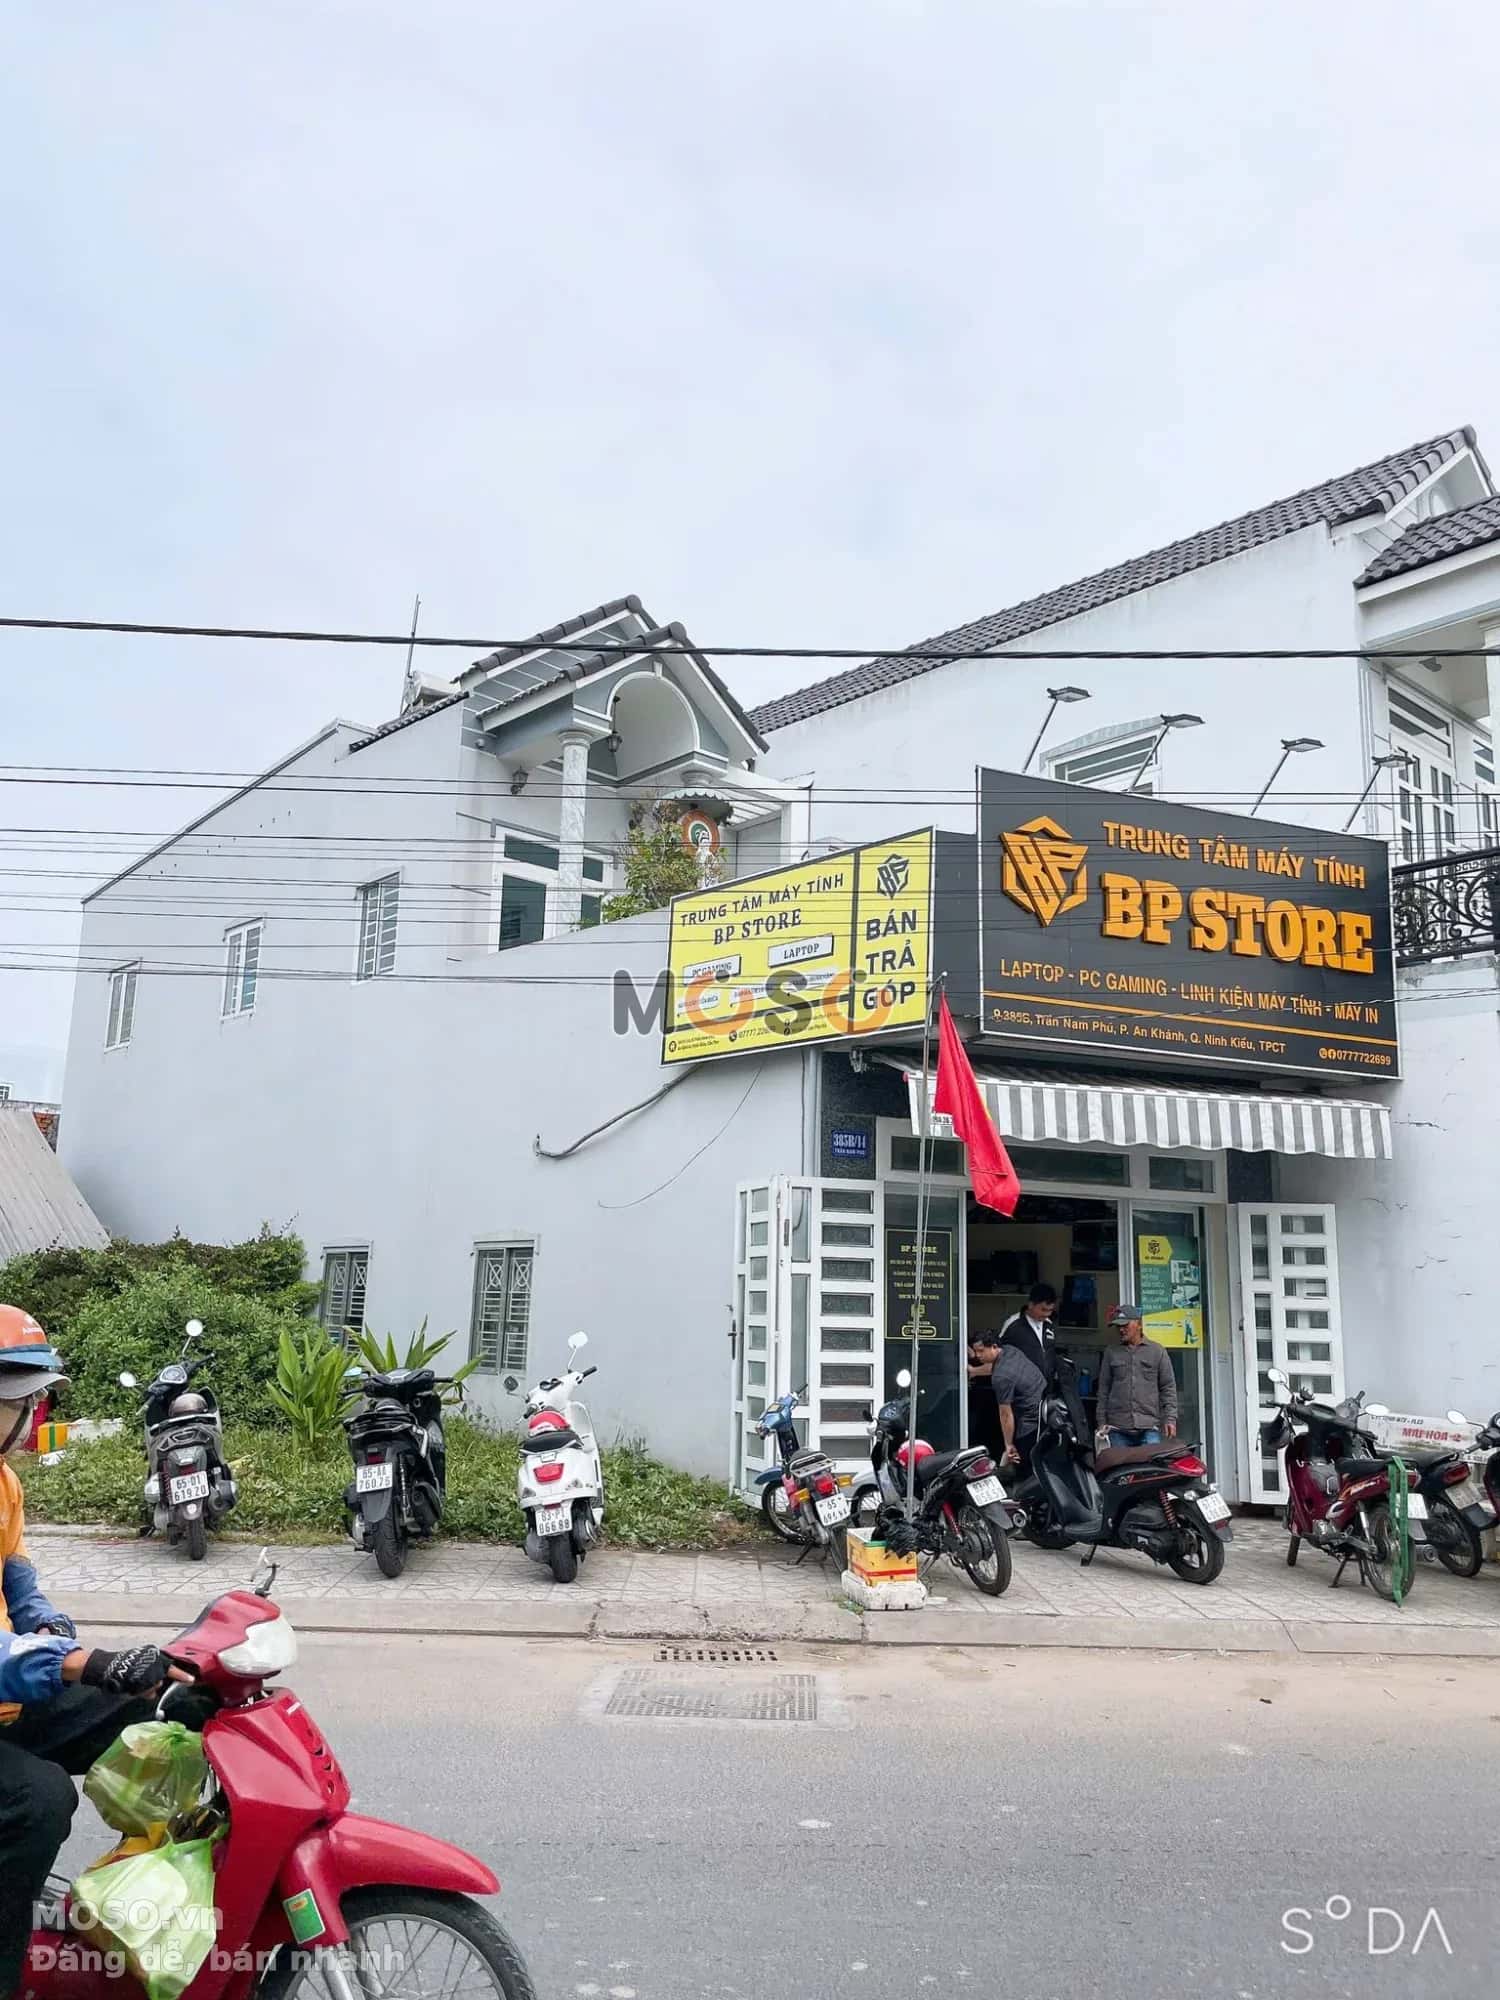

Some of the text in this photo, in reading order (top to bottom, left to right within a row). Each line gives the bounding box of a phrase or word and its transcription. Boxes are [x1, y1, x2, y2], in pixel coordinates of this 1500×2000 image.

[1102, 821, 1366, 889] TRUNG TÂM MÁY TÍNH
[680, 872, 844, 928] TRUNG TÂM MÁY TÍNH
[713, 908, 802, 946] BP STORE
[866, 908, 918, 941] BÁN
[1101, 872, 1375, 975] BP STORE
[783, 943, 820, 960] LAPTOP
[865, 940, 916, 975] TRẢ
[862, 980, 916, 1010] GÓP
[1000, 958, 1064, 984] LAPTOP
[1079, 968, 1101, 990] PC
[1105, 971, 1168, 997] GAMING
[1180, 982, 1215, 1004] LINH
[1219, 985, 1253, 1010] KIỆN
[1257, 988, 1287, 1011] MÁY
[1290, 991, 1322, 1018] TÍNH
[1364, 1004, 1379, 1025] IN
[1063, 1016, 1089, 1032] Nam
[1092, 1020, 1117, 1035] Phú,
[1119, 1023, 1129, 1035] P.
[1132, 1025, 1147, 1038] An
[1150, 1026, 1187, 1043] Khánh,
[1190, 1032, 1201, 1044] Q.
[1204, 1034, 1228, 1047] Ninh
[1259, 1040, 1286, 1054] TPCT
